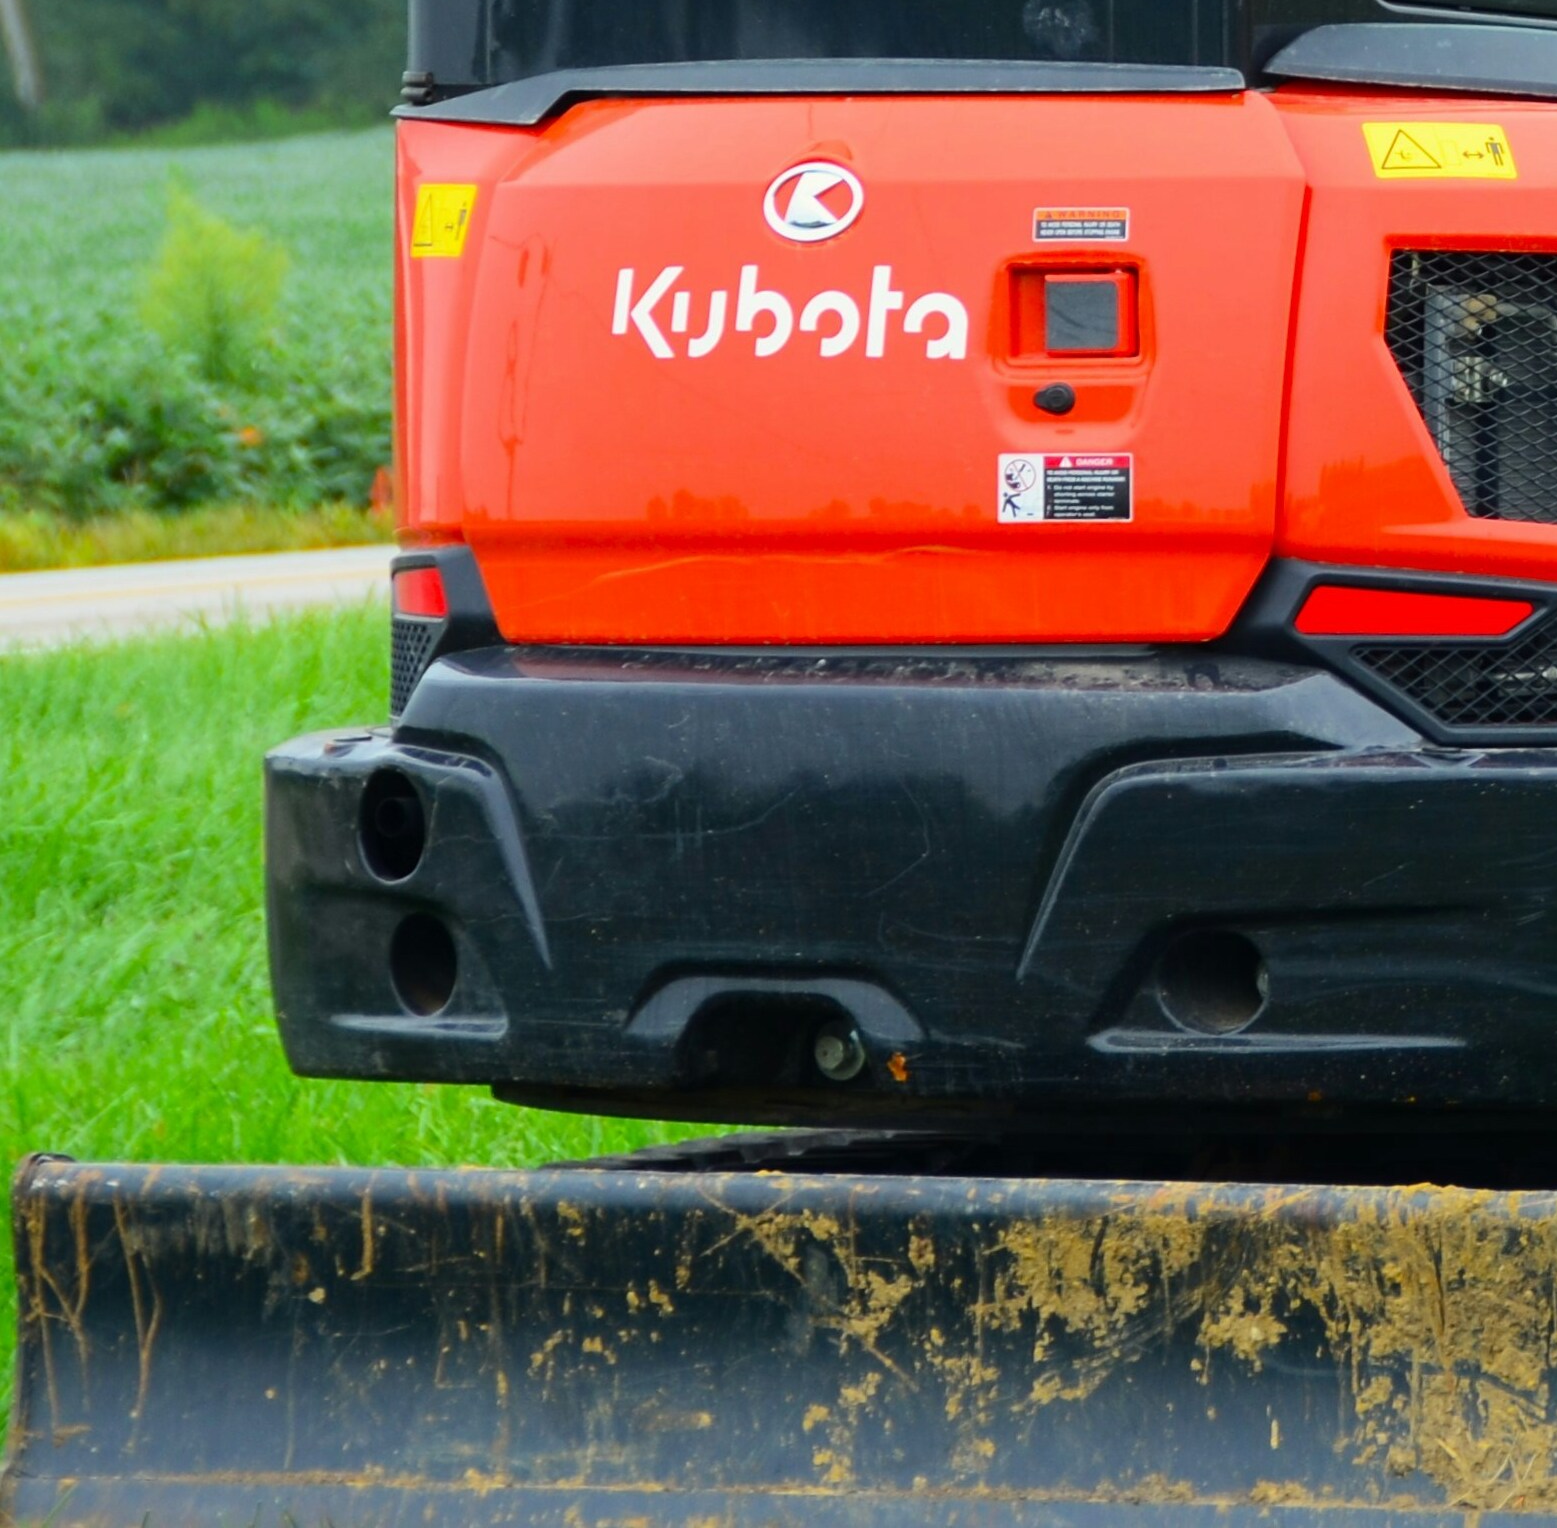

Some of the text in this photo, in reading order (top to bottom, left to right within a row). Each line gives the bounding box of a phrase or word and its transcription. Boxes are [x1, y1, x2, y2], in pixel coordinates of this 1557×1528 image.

[1058, 211, 1120, 219] WARNING
[612, 265, 969, 360] Kubota
[1075, 458, 1114, 466] DANGER
